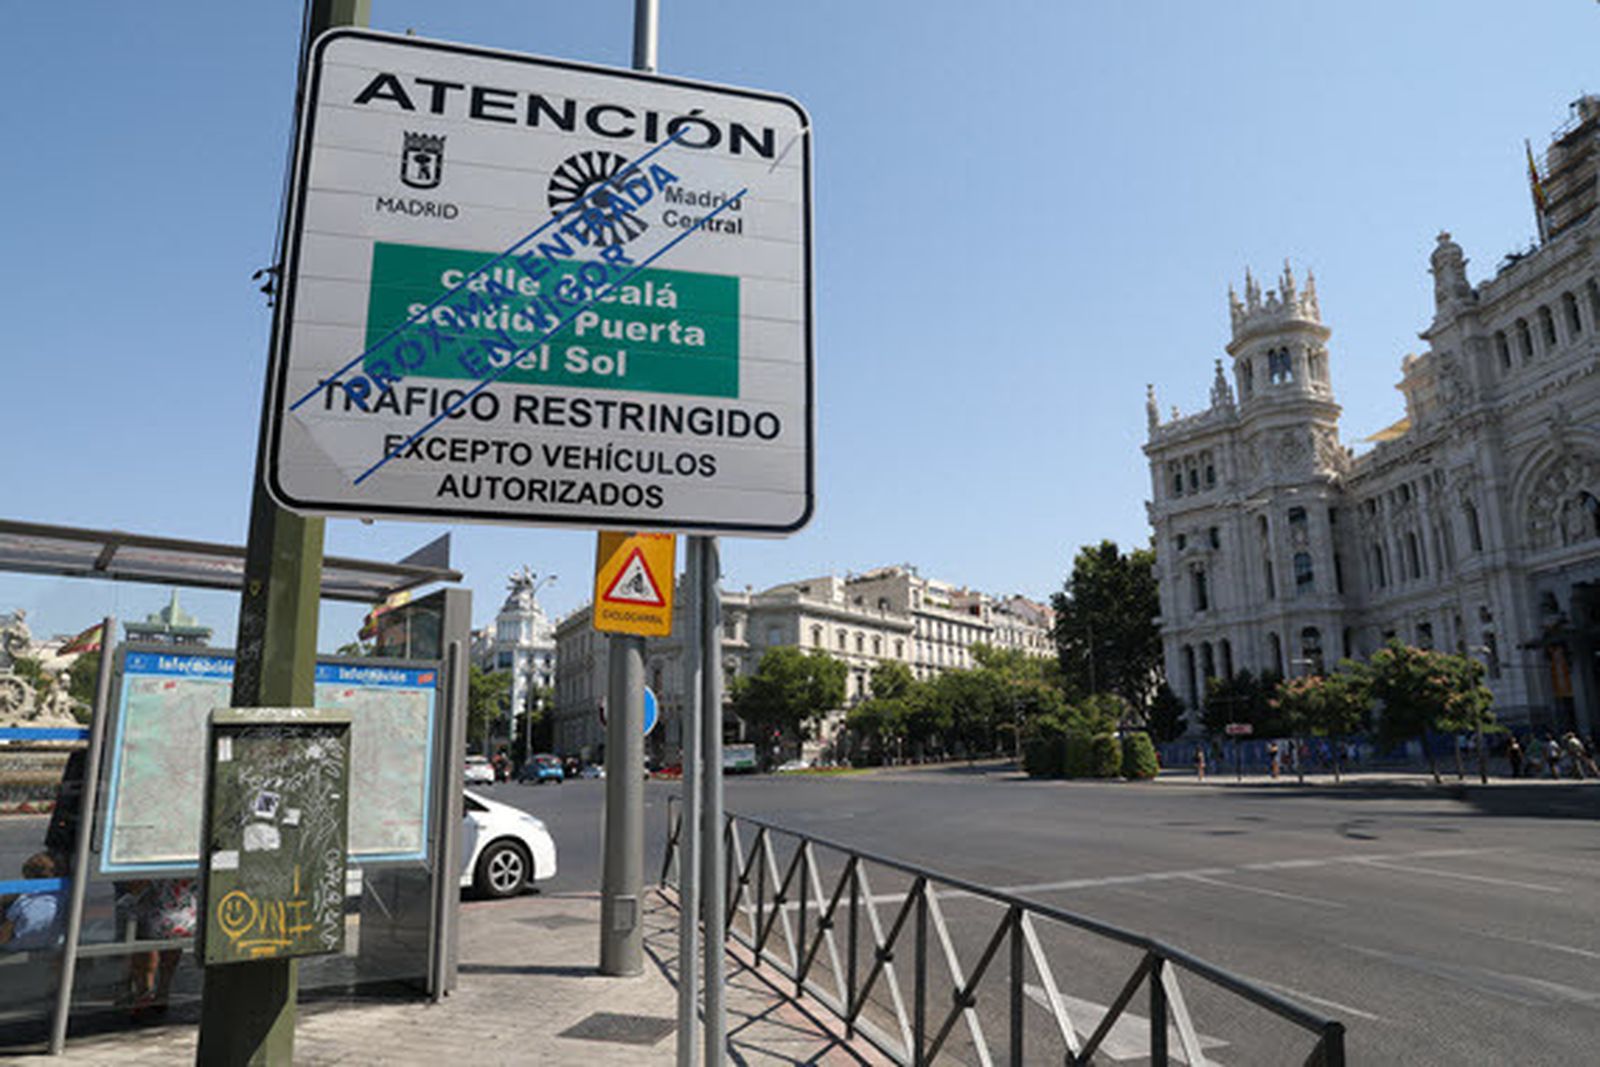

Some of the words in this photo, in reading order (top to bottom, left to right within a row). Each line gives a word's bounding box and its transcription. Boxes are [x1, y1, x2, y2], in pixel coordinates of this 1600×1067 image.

[354, 73, 774, 158] ATENCIÓN
[376, 197, 460, 220] MADRID
[665, 186, 742, 211] Madrid
[517, 163, 679, 281] ENTRADA
[662, 209, 743, 235] Central
[441, 266, 541, 297] calle
[407, 302, 560, 334] sentido
[575, 310, 706, 347] Puerta
[458, 327, 518, 379] EN
[520, 243, 635, 330] VIGOR
[564, 345, 627, 377] Sol
[318, 378, 500, 422] TRÁFICO
[513, 394, 781, 440] RESTRINGIDO
[384, 434, 533, 466] EXCEPTO
[542, 443, 717, 477] VEHÍCULOS
[436, 473, 664, 509] AUTORIZADOS
